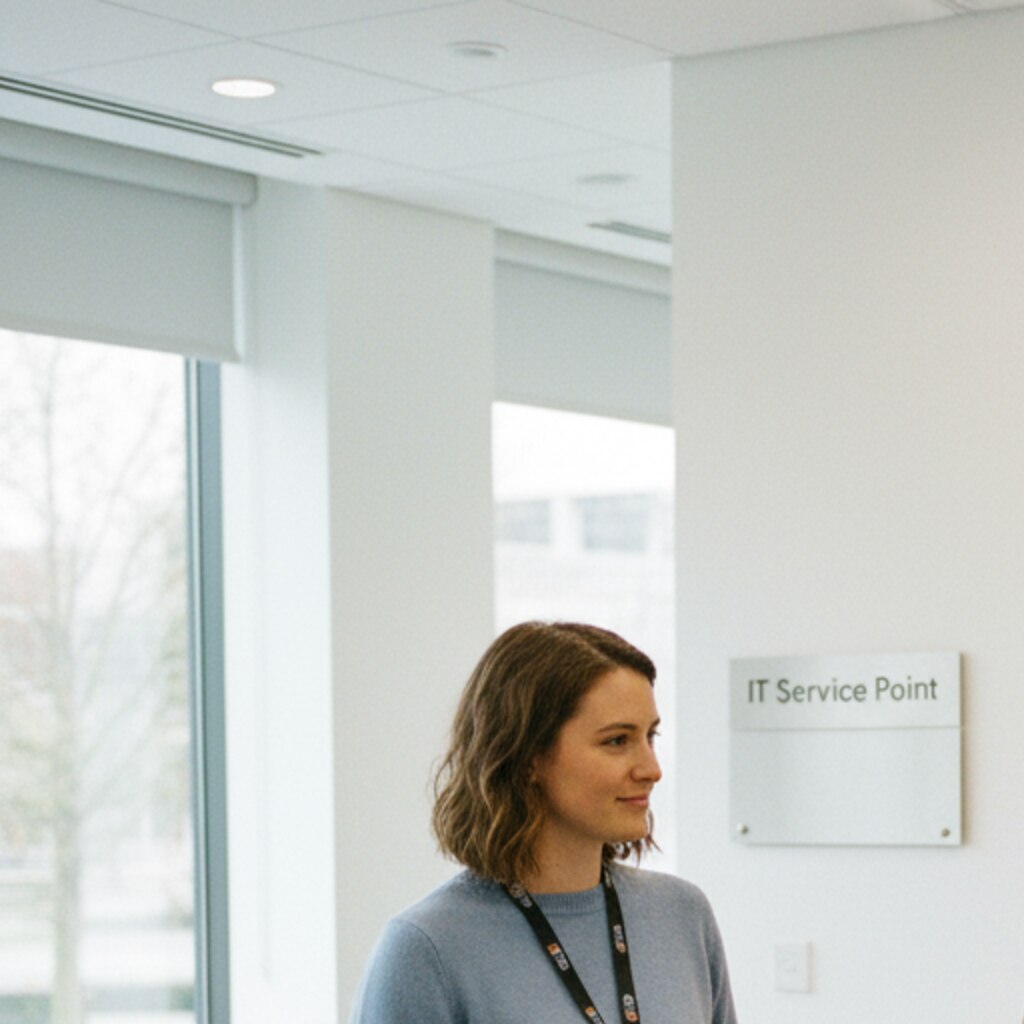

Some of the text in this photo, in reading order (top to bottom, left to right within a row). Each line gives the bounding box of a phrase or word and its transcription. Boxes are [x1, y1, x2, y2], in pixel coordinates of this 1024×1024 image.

[748, 676, 939, 704] IT Service Point
